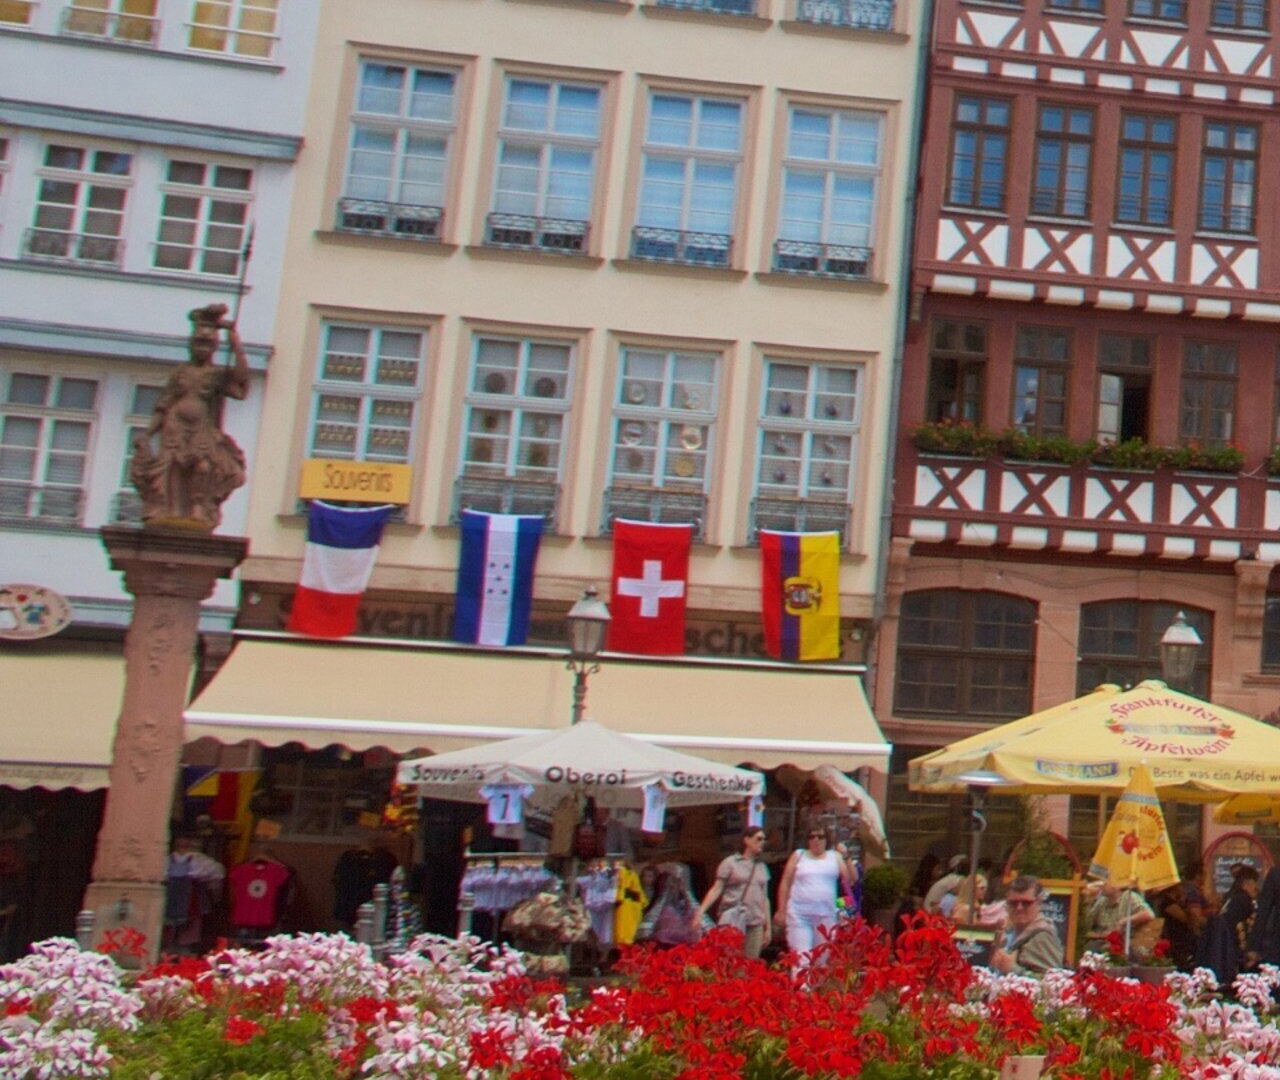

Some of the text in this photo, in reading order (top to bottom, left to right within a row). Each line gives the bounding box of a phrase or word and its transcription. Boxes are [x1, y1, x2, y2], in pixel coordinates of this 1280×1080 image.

[1110, 697, 1223, 719] Frankfurter
[545, 765, 627, 785] Oberoi
[672, 770, 754, 792] Geschenke
[1153, 767, 1185, 778] Beste
[1189, 770, 1211, 779] was
[1213, 769, 1232, 780] ein
[1234, 769, 1266, 783] Apfel
